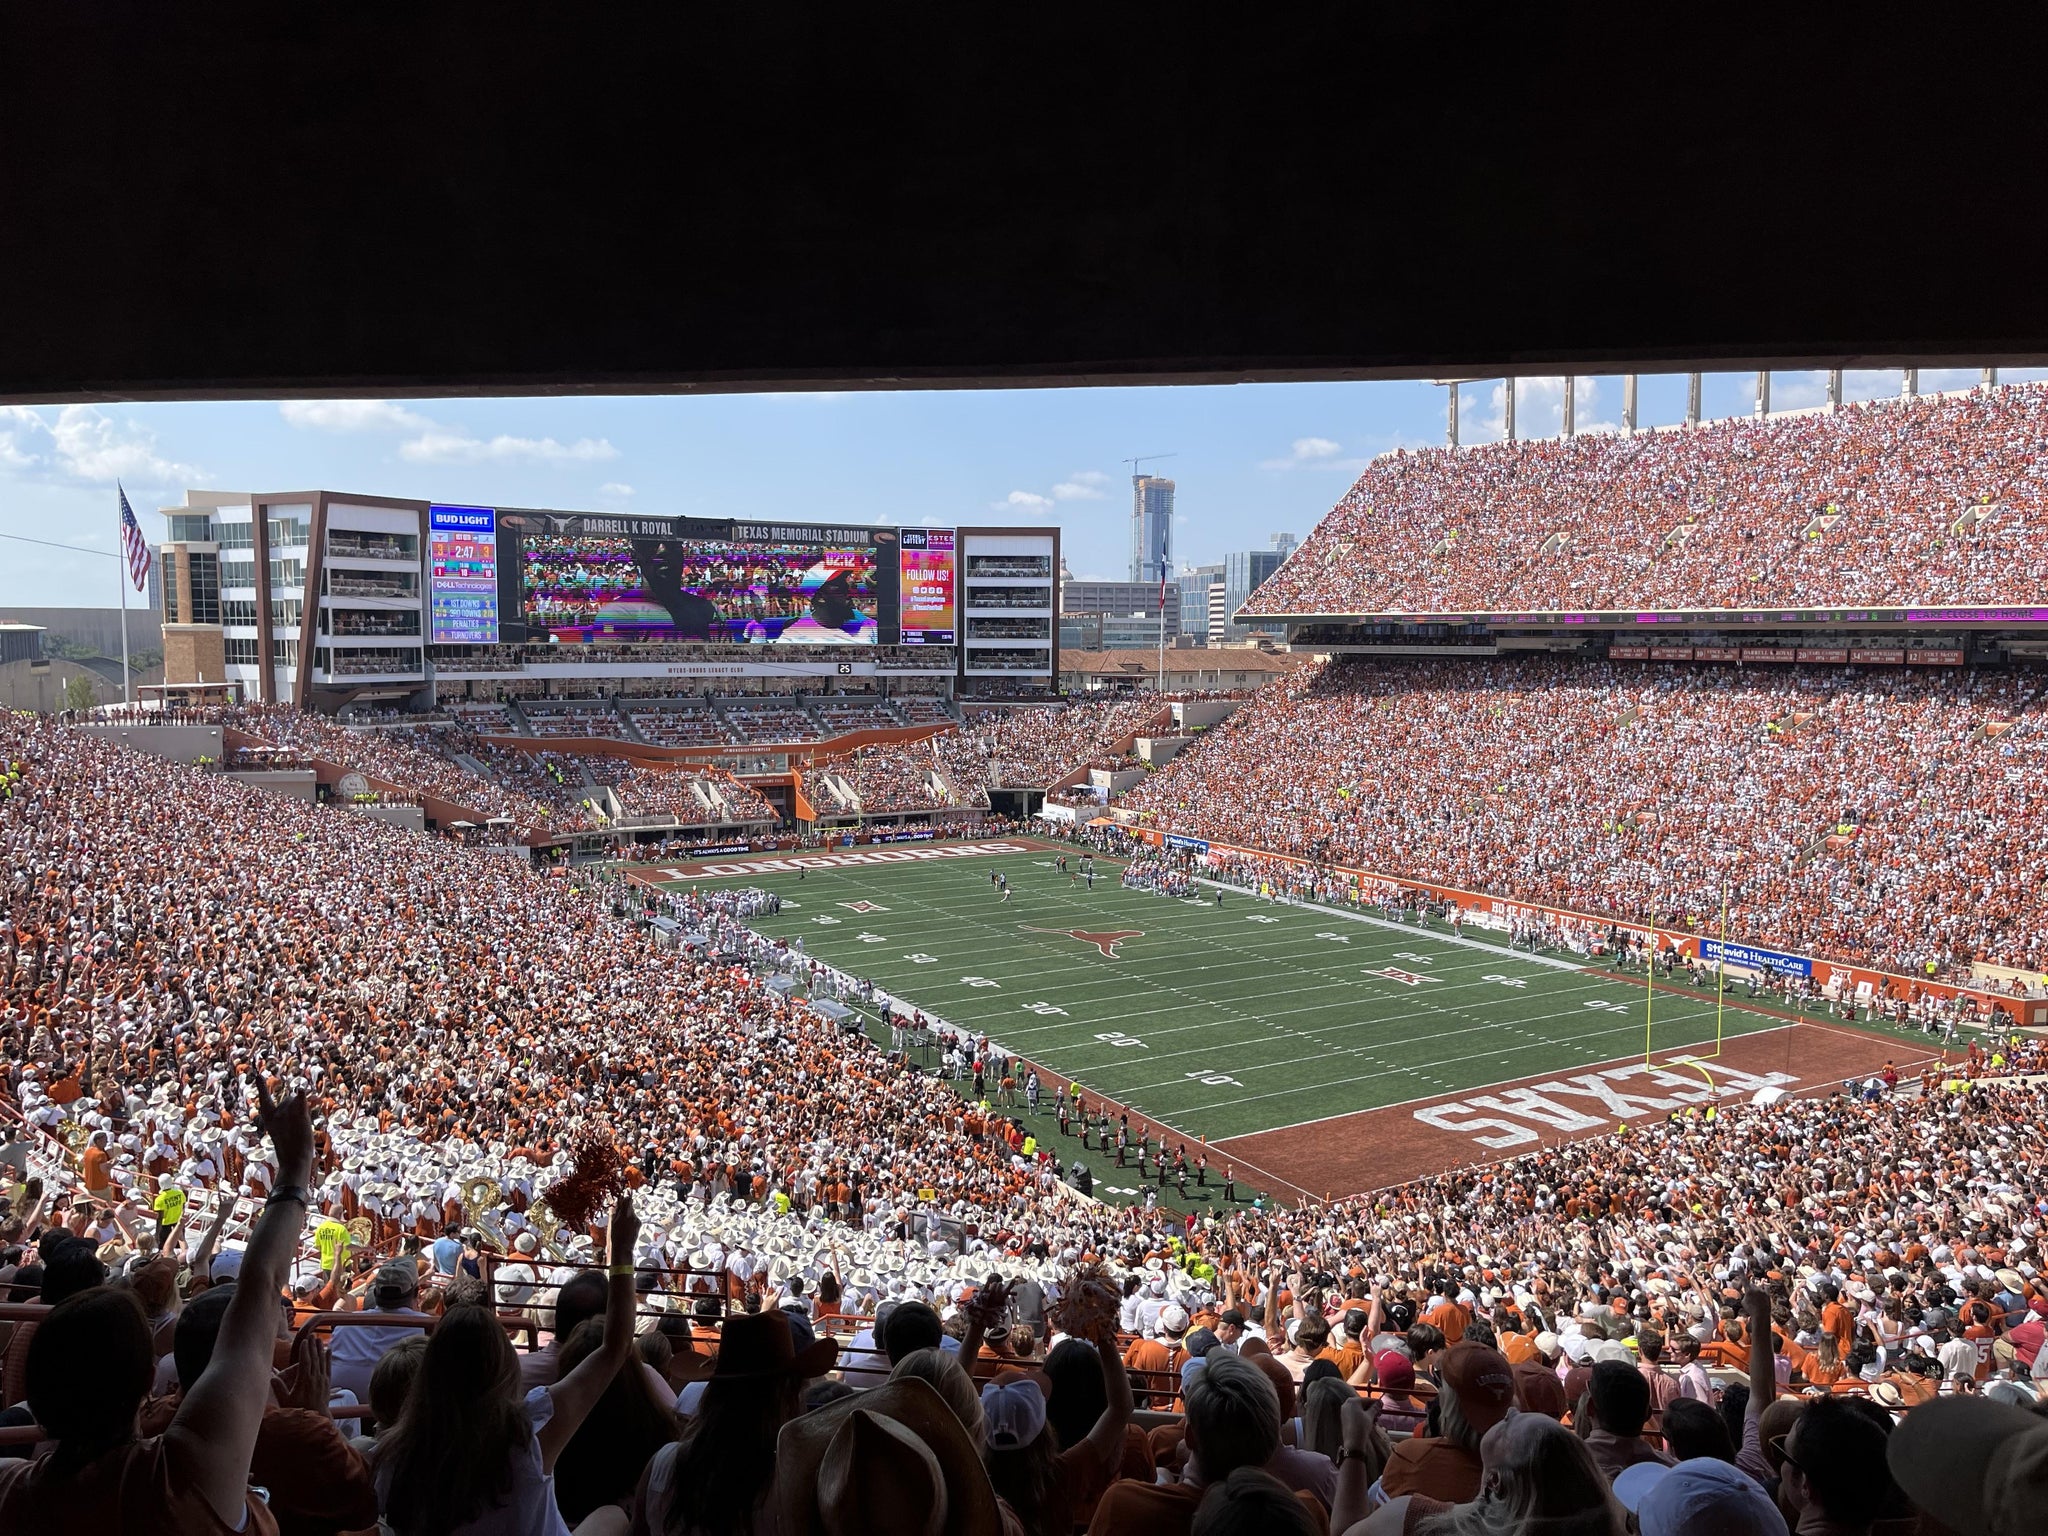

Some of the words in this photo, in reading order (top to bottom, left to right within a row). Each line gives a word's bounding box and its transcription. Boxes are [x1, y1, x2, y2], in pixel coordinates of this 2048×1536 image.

[436, 514, 458, 523] BUD
[459, 516, 489, 525] LIGHT
[583, 518, 629, 534] DARRELL
[632, 520, 639, 534] K
[642, 522, 673, 535] ROYAL
[738, 526, 768, 539] TEXAS
[771, 527, 824, 542] MEMORIAL
[826, 530, 868, 544] STADIUM
[438, 544, 444, 556] 3
[455, 546, 474, 558] 2:47
[484, 546, 490, 558] 3
[906, 569, 936, 581] FOLLOW
[936, 570, 949, 582] US!
[1916, 610, 1942, 618] CARE
[1947, 610, 1978, 618] CLOSE
[1984, 609, 1998, 618] TO
[2002, 608, 2034, 618] HOME
[1798, 652, 1807, 660] 20
[839, 664, 850, 673] 25
[656, 842, 1028, 880] LONGHORNS
[903, 953, 938, 964] 50
[1021, 1002, 1063, 1016] 30
[1094, 1032, 1142, 1047] 20
[1185, 1070, 1234, 1085] 10
[1413, 1054, 1801, 1149] TEXAS
[164, 1194, 181, 1204] EVENT
[1978, 1344, 1990, 1364] 5
